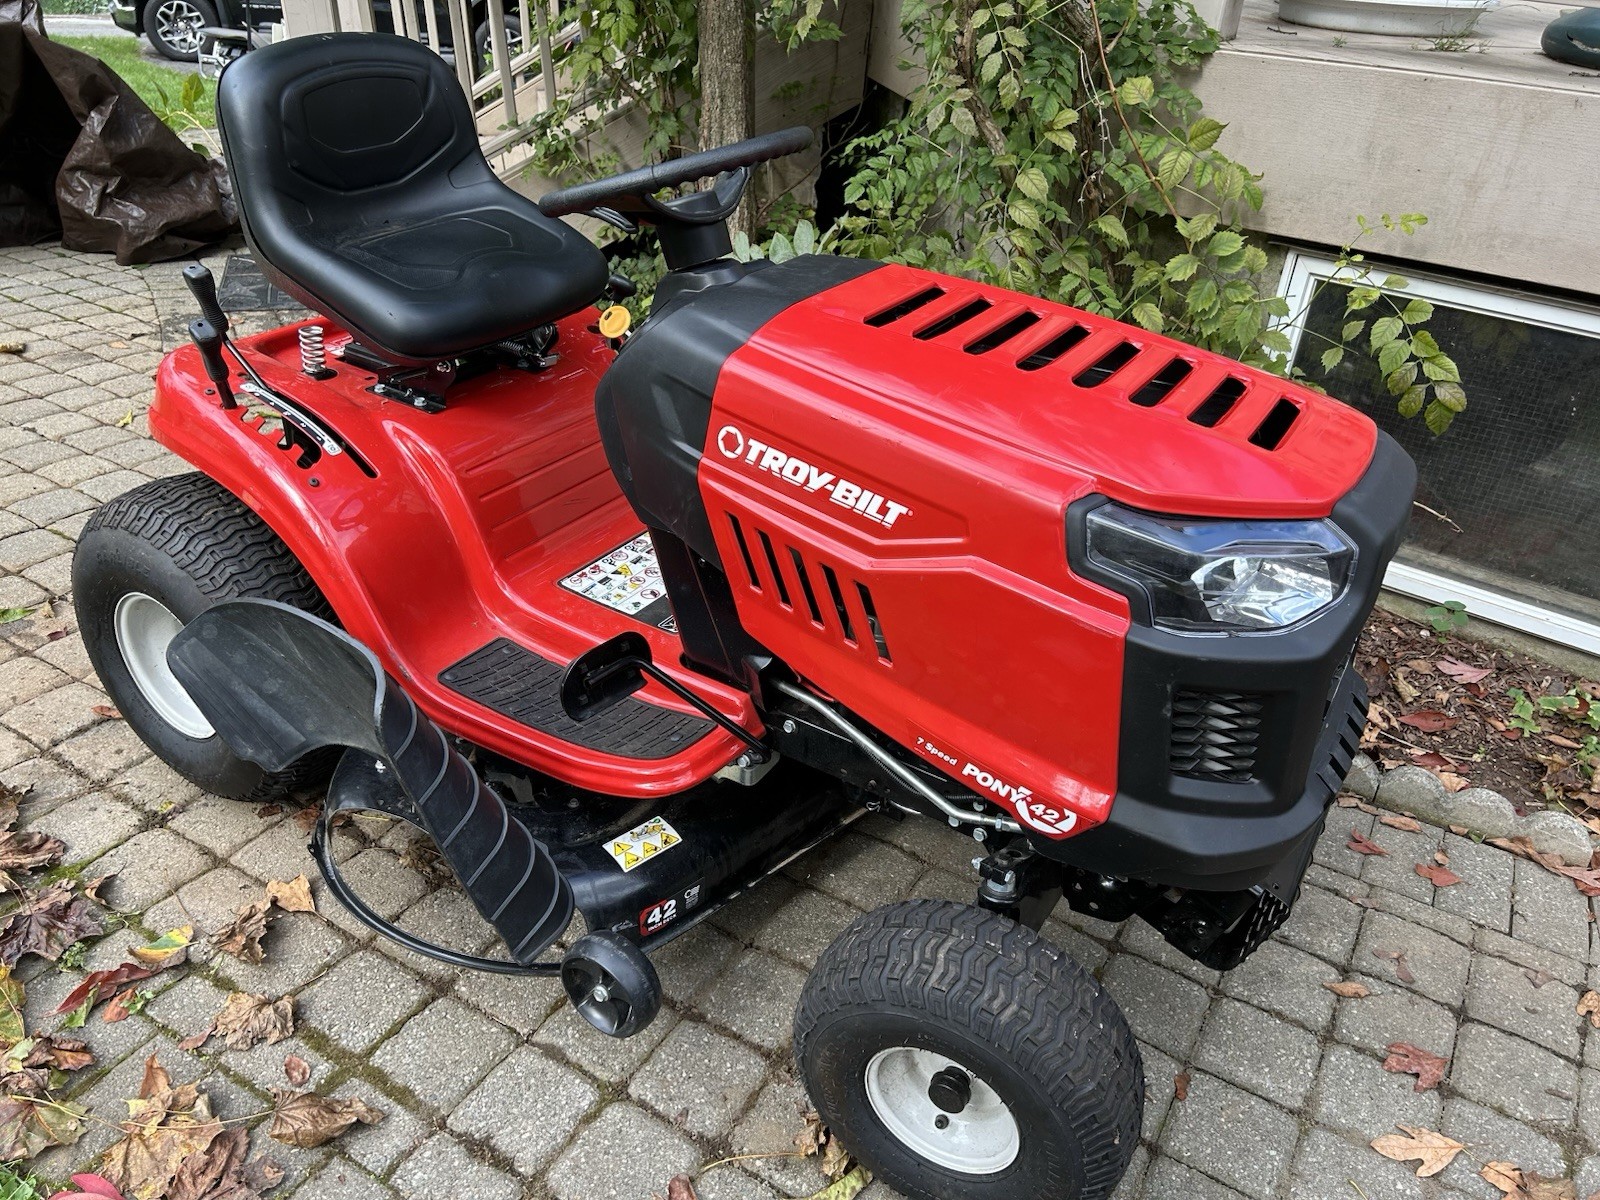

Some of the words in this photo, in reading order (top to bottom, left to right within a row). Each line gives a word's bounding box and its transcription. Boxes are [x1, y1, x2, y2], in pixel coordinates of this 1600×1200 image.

[744, 437, 909, 530] TROY-BILT
[916, 736, 925, 745] 7
[925, 742, 958, 766] Speed
[961, 762, 1032, 804] PONY
[1029, 803, 1060, 823] 42
[647, 899, 677, 924] 42
